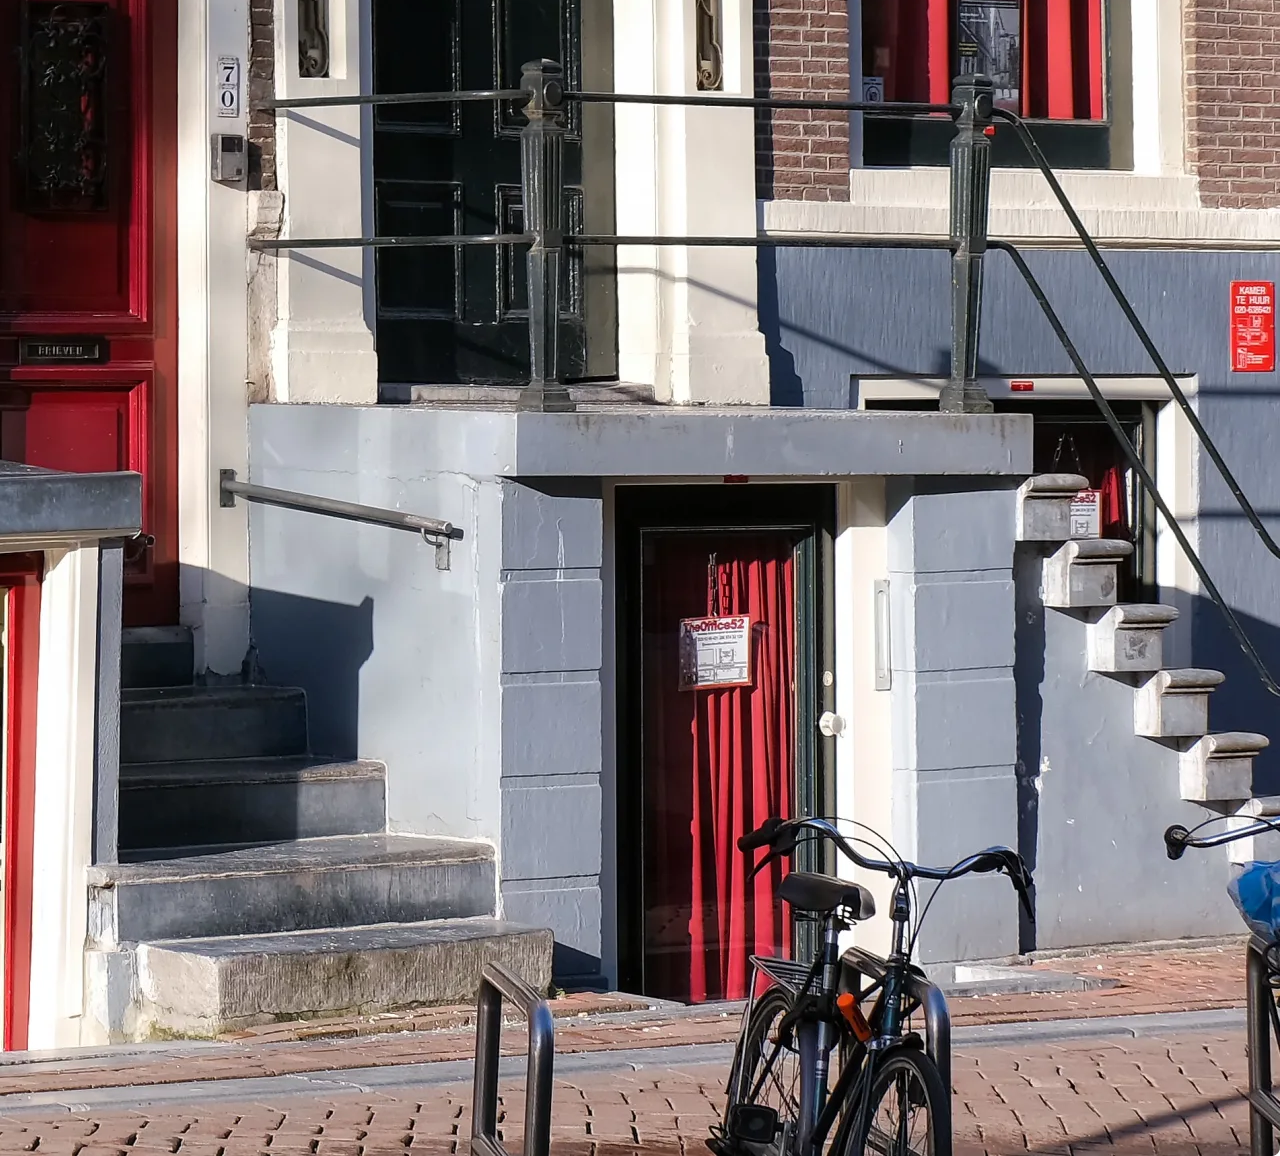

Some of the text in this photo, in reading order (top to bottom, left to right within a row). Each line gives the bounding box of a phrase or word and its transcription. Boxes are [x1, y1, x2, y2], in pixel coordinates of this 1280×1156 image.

[1239, 286, 1266, 295] KAMER
[1236, 295, 1270, 304] TE HUUR
